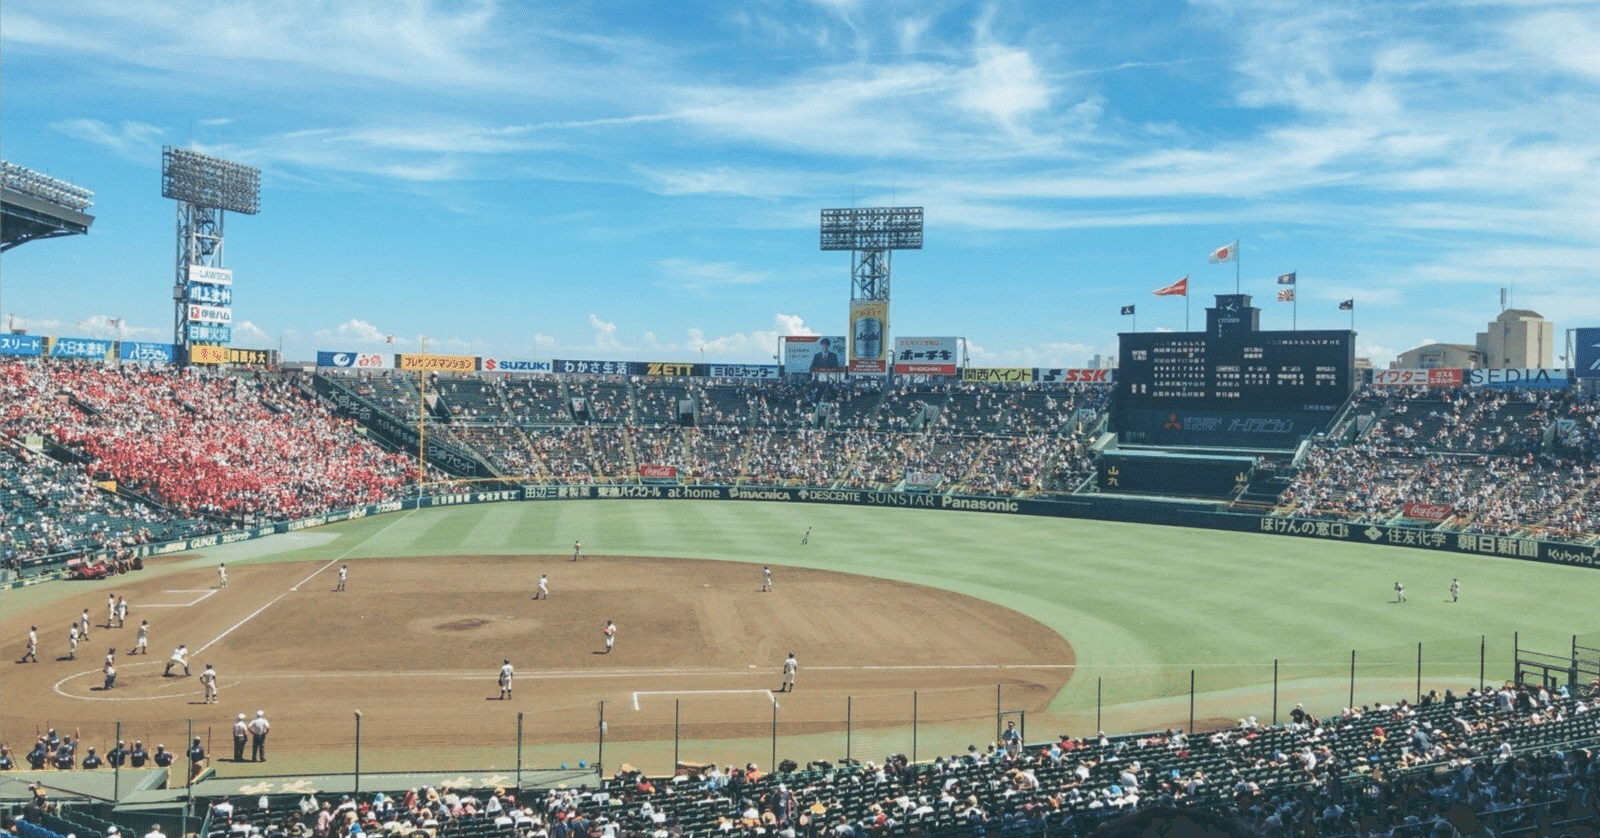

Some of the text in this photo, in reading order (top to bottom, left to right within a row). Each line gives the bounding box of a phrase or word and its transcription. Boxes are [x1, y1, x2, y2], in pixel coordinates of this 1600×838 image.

[191, 327, 229, 341] 日新火災
[57, 340, 106, 356] 大日本塗料
[899, 349, 952, 361] ホーチキ
[500, 361, 550, 371] SUZUKI
[564, 361, 628, 373] わかさ生活
[647, 363, 694, 376] ZETT
[714, 367, 774, 377] 三和シャッター
[964, 368, 1031, 381] 関西ペイント
[1065, 369, 1109, 381] SSK
[1374, 370, 1427, 383] イワタニ
[1470, 369, 1552, 384] SEDIA
[328, 388, 371, 420] 大同生命
[1108, 466, 1119, 486] 山九
[525, 487, 590, 498] 田辺三菱製薬
[598, 487, 661, 498] 東進ハイスクール
[667, 486, 720, 498] at home
[810, 491, 860, 502] DESCENTE
[867, 493, 934, 506] SUNSTAR
[942, 494, 1019, 511] Panasonic
[1260, 518, 1343, 538] ほけんの窓口
[191, 536, 217, 548] GUNZE
[1386, 528, 1446, 547] 住友化学
[1458, 534, 1538, 557] 朝日新聞
[1548, 548, 1593, 565] Kubota
